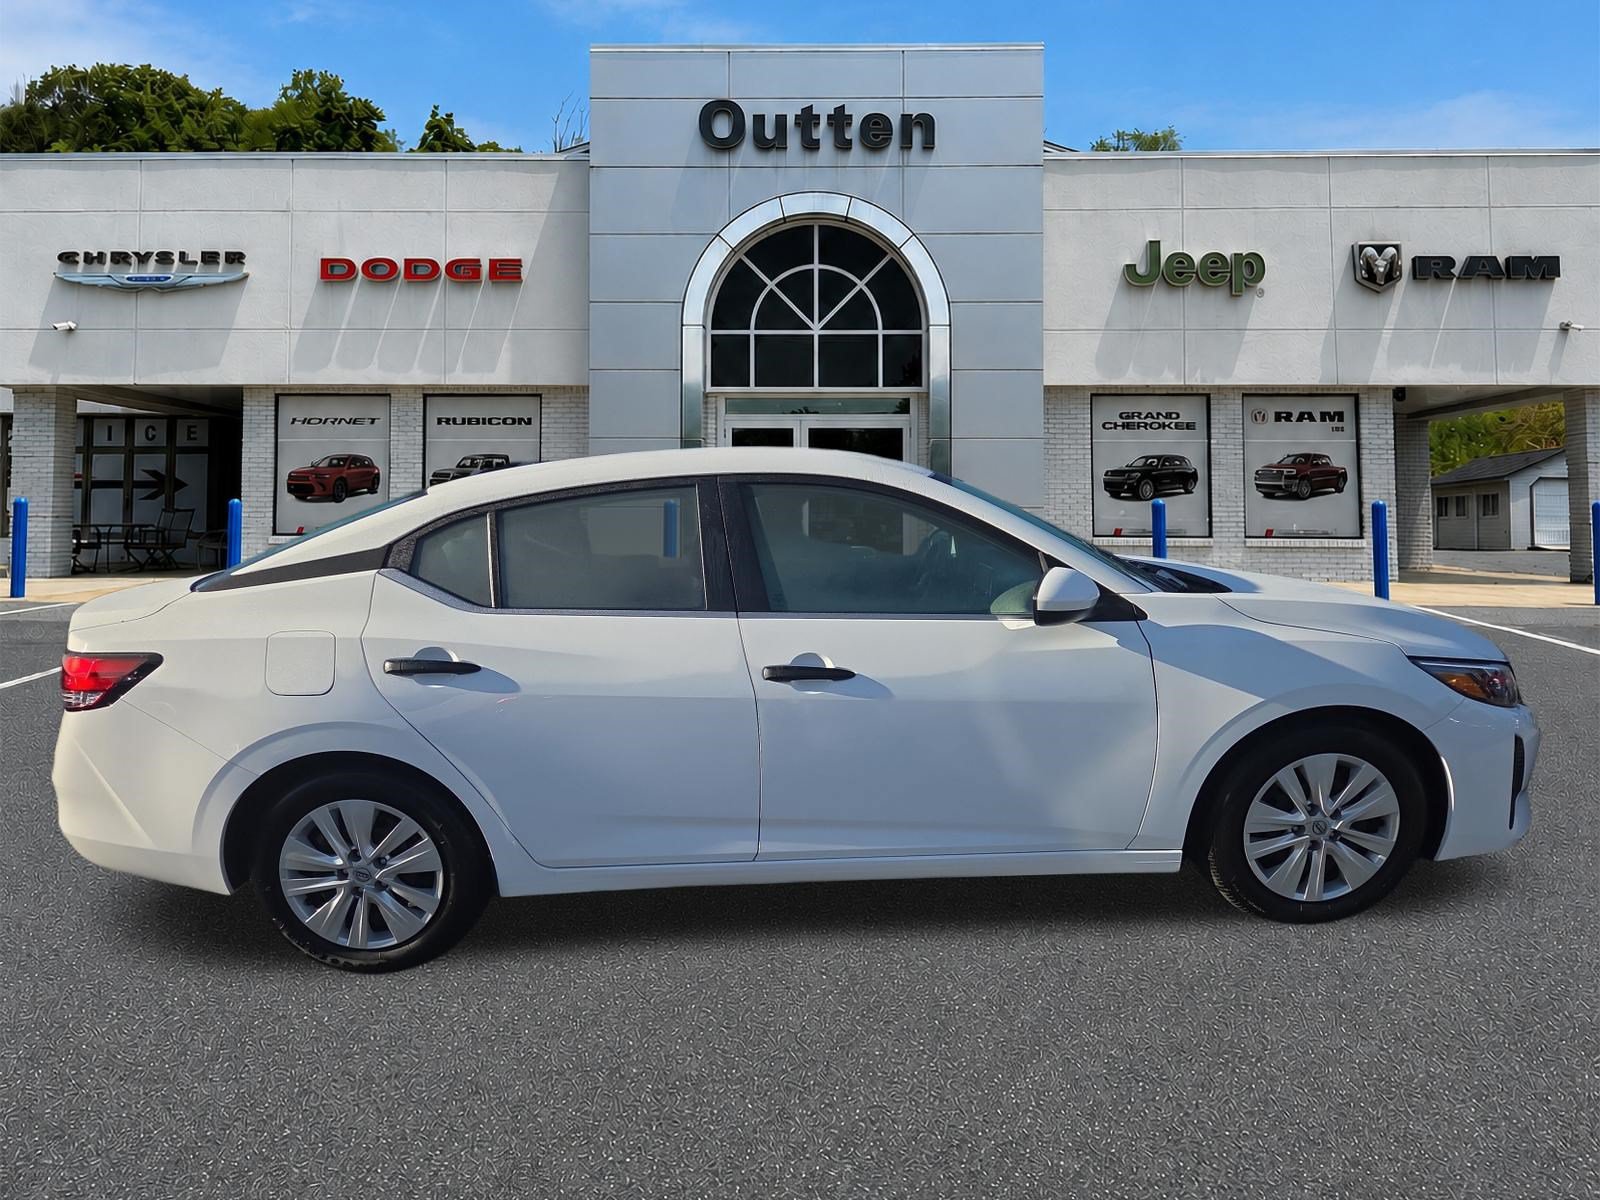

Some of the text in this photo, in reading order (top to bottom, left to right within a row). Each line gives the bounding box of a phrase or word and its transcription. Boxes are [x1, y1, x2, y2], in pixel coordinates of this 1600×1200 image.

[699, 99, 936, 151] Outten
[57, 250, 247, 266] CHRYSLER
[319, 257, 523, 283] DODGE
[1123, 240, 1266, 297] Jeep
[1412, 255, 1560, 280] RAM
[290, 417, 381, 426] HORNET
[436, 416, 533, 426] RUBICON
[1118, 411, 1181, 421] GRAND
[1274, 411, 1345, 423] RAM
[1101, 421, 1197, 431] CHEROKEE
